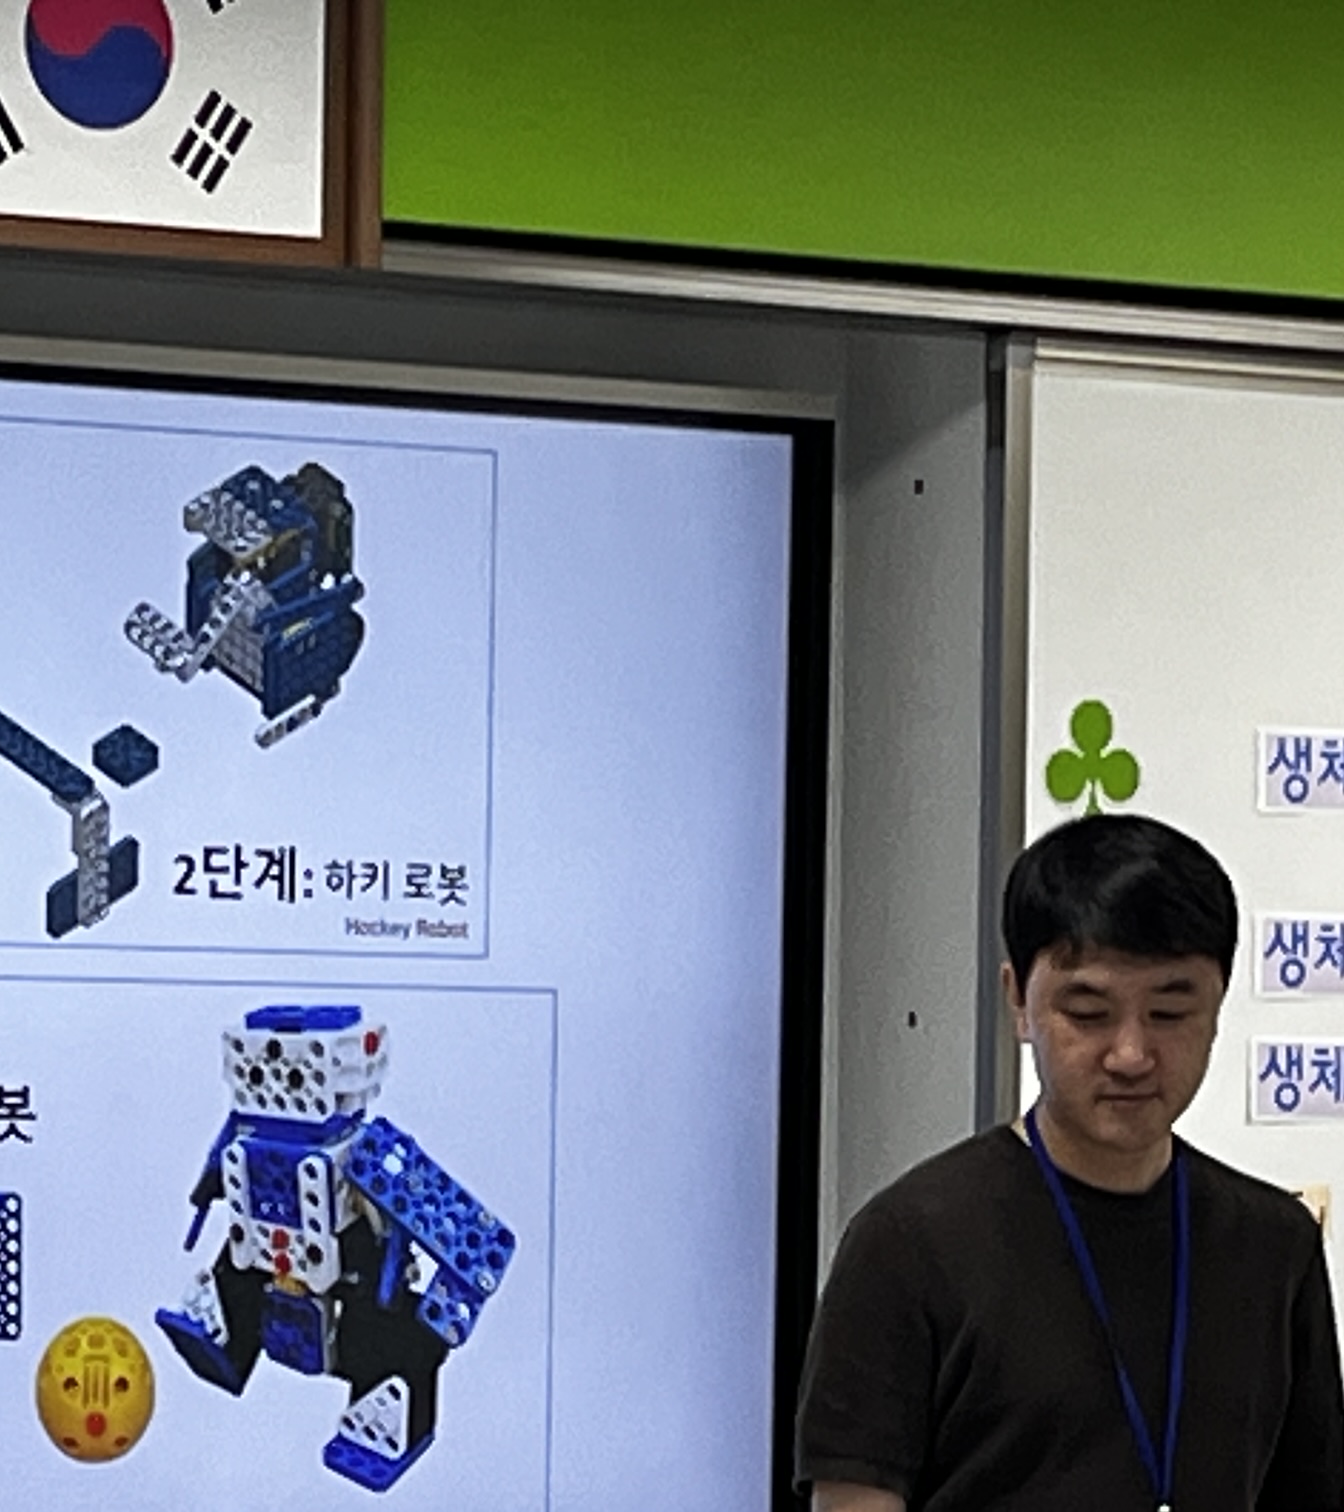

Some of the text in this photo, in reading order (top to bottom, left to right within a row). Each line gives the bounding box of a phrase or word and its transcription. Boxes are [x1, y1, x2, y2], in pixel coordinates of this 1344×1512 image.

[173, 843, 469, 907] 2단계: 하키 로봇
[345, 917, 469, 941] Hockey Robot
